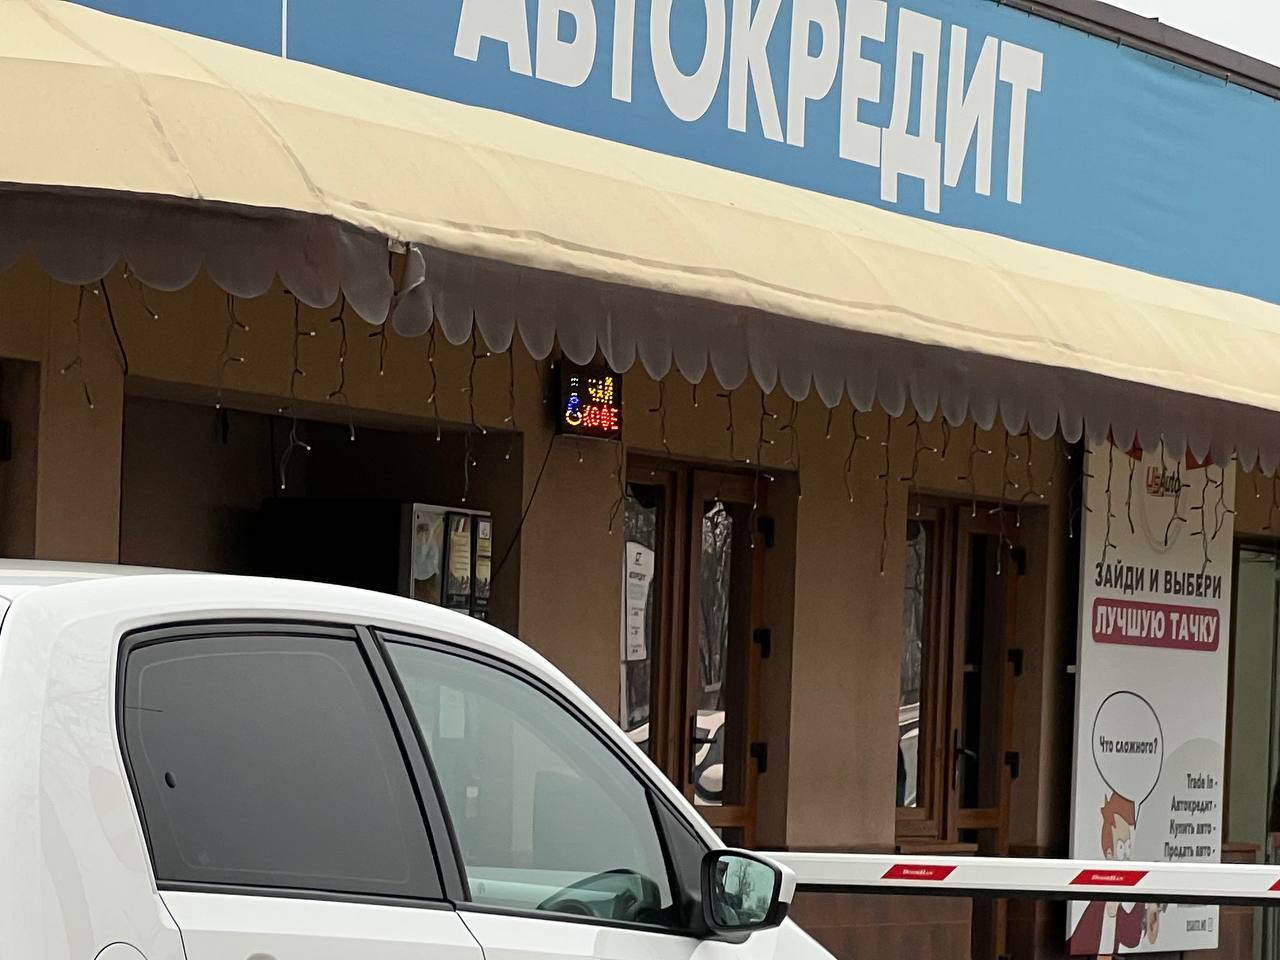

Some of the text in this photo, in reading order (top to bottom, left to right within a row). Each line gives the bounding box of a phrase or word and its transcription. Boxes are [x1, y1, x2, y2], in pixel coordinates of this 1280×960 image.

[582, 404, 619, 430] КОФЕ
[1094, 560, 1222, 600] ЗАЙДИ И ВЫБЕРИ
[1094, 605, 1218, 643] ЛУЧШУЮ ТАЧКУ
[1099, 735, 1114, 753] Что
[1186, 772, 1206, 790] Trade
[1170, 795, 1213, 817] Автокредит
[1169, 819, 1212, 840] Купить авто
[1164, 842, 1212, 862] Продать авто
